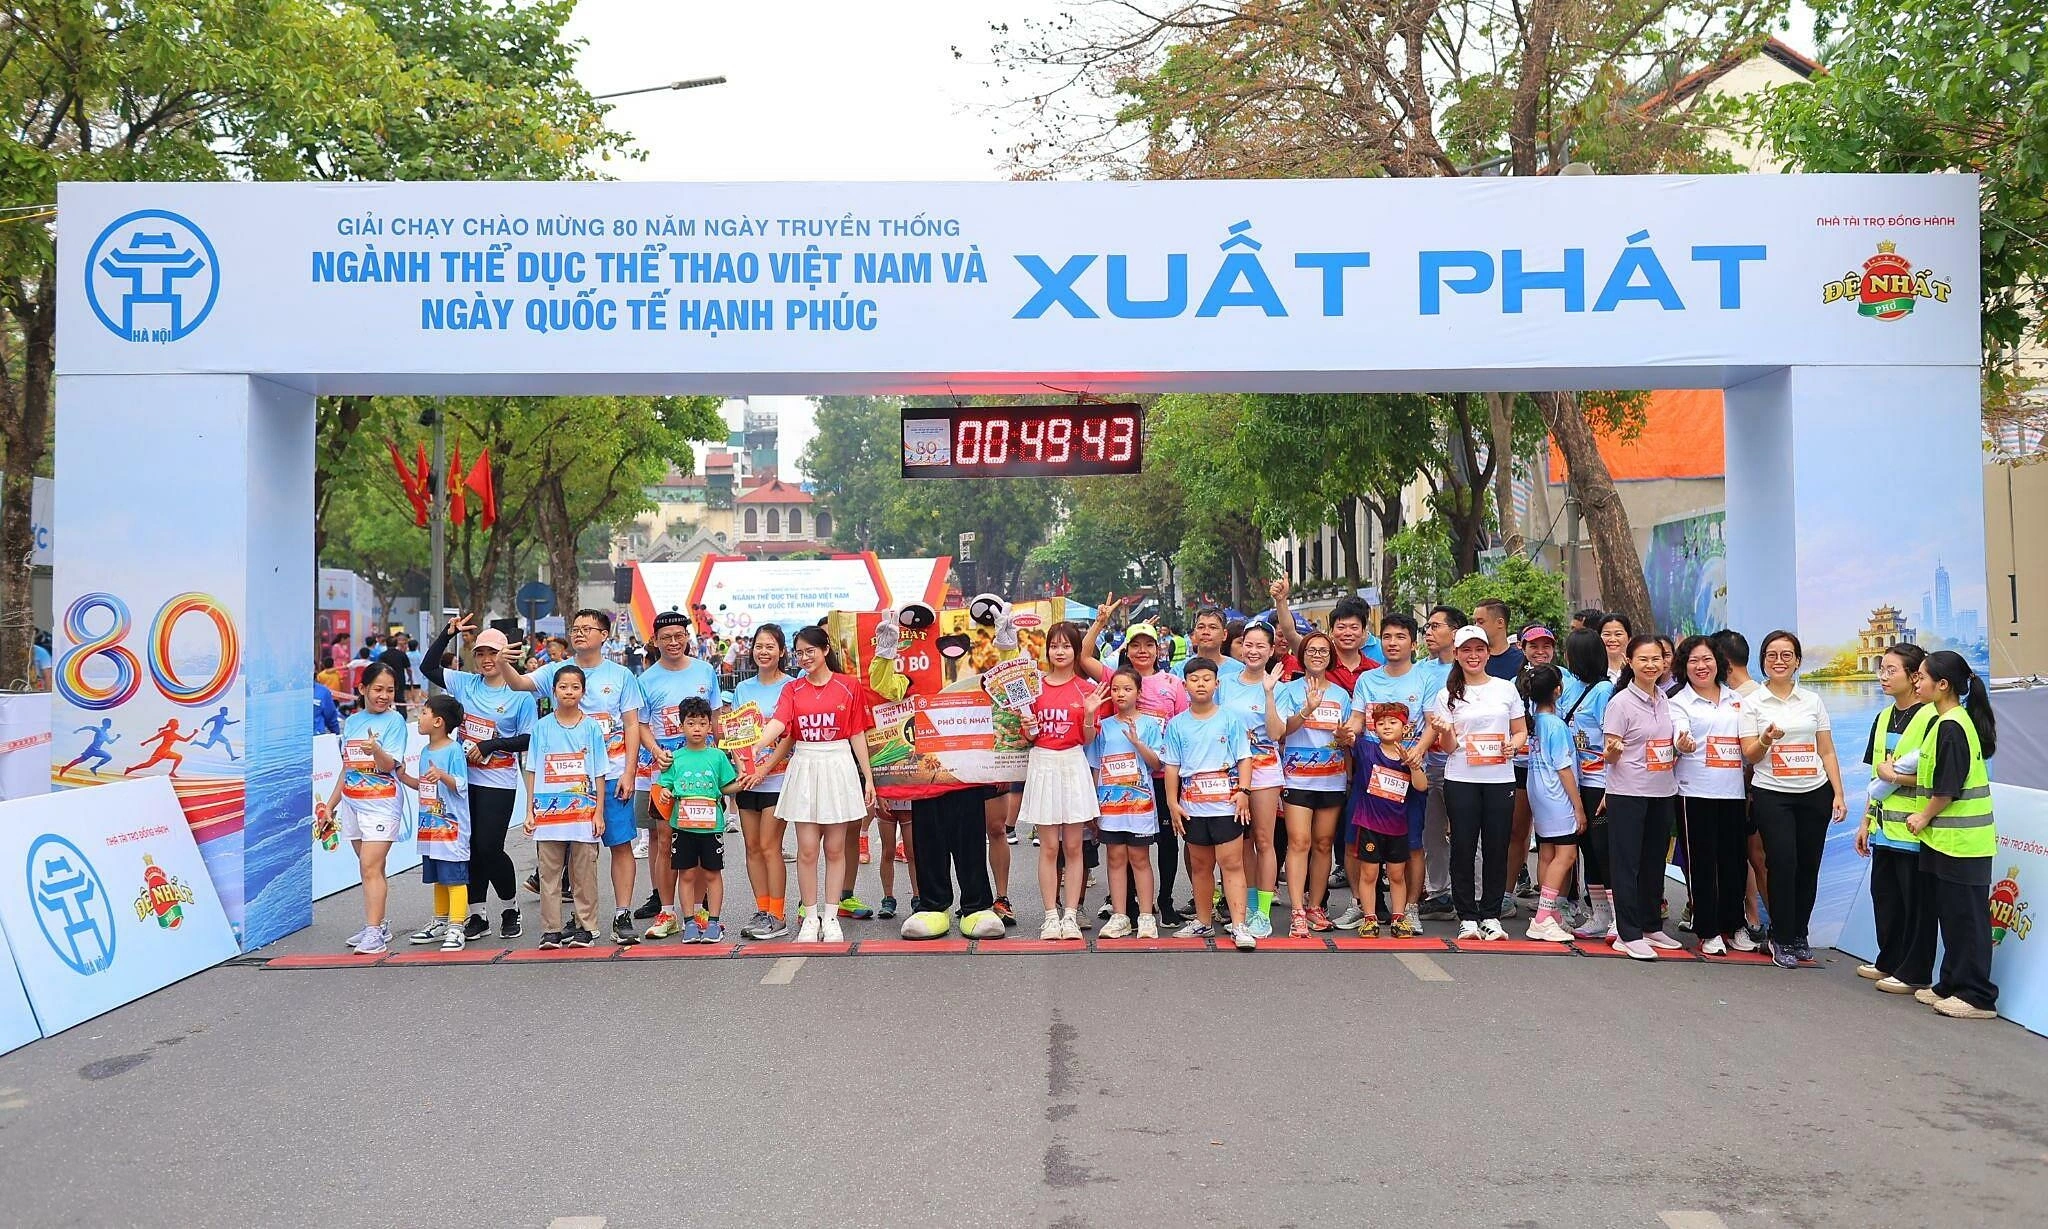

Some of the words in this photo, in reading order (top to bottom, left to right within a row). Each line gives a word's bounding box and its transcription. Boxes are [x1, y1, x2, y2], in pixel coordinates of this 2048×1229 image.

[337, 211, 383, 236] GIẢI
[391, 217, 455, 240] CHẠY
[463, 214, 529, 236] CHÀO
[537, 214, 605, 237] MỪNG
[613, 219, 638, 237] 80
[645, 214, 696, 237] NĂM
[704, 215, 769, 237] NGÀY
[777, 212, 871, 237] TRUYỀN
[879, 211, 960, 237] THỐNG
[1816, 216, 1840, 226] NHÀ
[1844, 216, 1860, 226] TÀI
[1863, 217, 1886, 228] TRỢ
[1888, 214, 1921, 226] ĐỒNG
[1924, 216, 1956, 226] HÀNH
[312, 243, 431, 284] NGÀNH
[440, 242, 513, 284] THỂ
[517, 251, 587, 291] DỤC
[595, 242, 668, 284] THỂ
[669, 251, 760, 284] THAO
[768, 244, 843, 291] VIỆT
[854, 251, 932, 284] NAM
[942, 244, 988, 284] VÀ
[1013, 219, 1371, 320] XUẤT
[1418, 229, 1768, 316] PHÁT
[1823, 271, 1861, 304] ĐỆ
[1869, 269, 1952, 304] NHẤT
[421, 290, 515, 331] NGÀY
[525, 287, 617, 335] QUỐC
[626, 287, 672, 331] TẾ
[679, 299, 774, 339] HẠNH
[786, 290, 878, 332] PHÚC
[1875, 300, 1898, 314] PHỞ
[132, 328, 150, 343] HÀ
[152, 328, 171, 345] NỘI
[55, 591, 241, 711] 80
[909, 650, 930, 672] BÒ
[798, 712, 835, 729] RUN
[1317, 708, 1339, 718] 1151-2
[468, 723, 490, 736] 1156-1
[555, 761, 582, 769] 1154-2
[1109, 761, 1135, 771] 1108-2
[1785, 755, 1814, 763] V-8037
[1201, 780, 1227, 789] 1134-3
[1383, 776, 1406, 789] 1151-3
[689, 807, 714, 815] 1137-3
[151, 875, 195, 905] NHẤT
